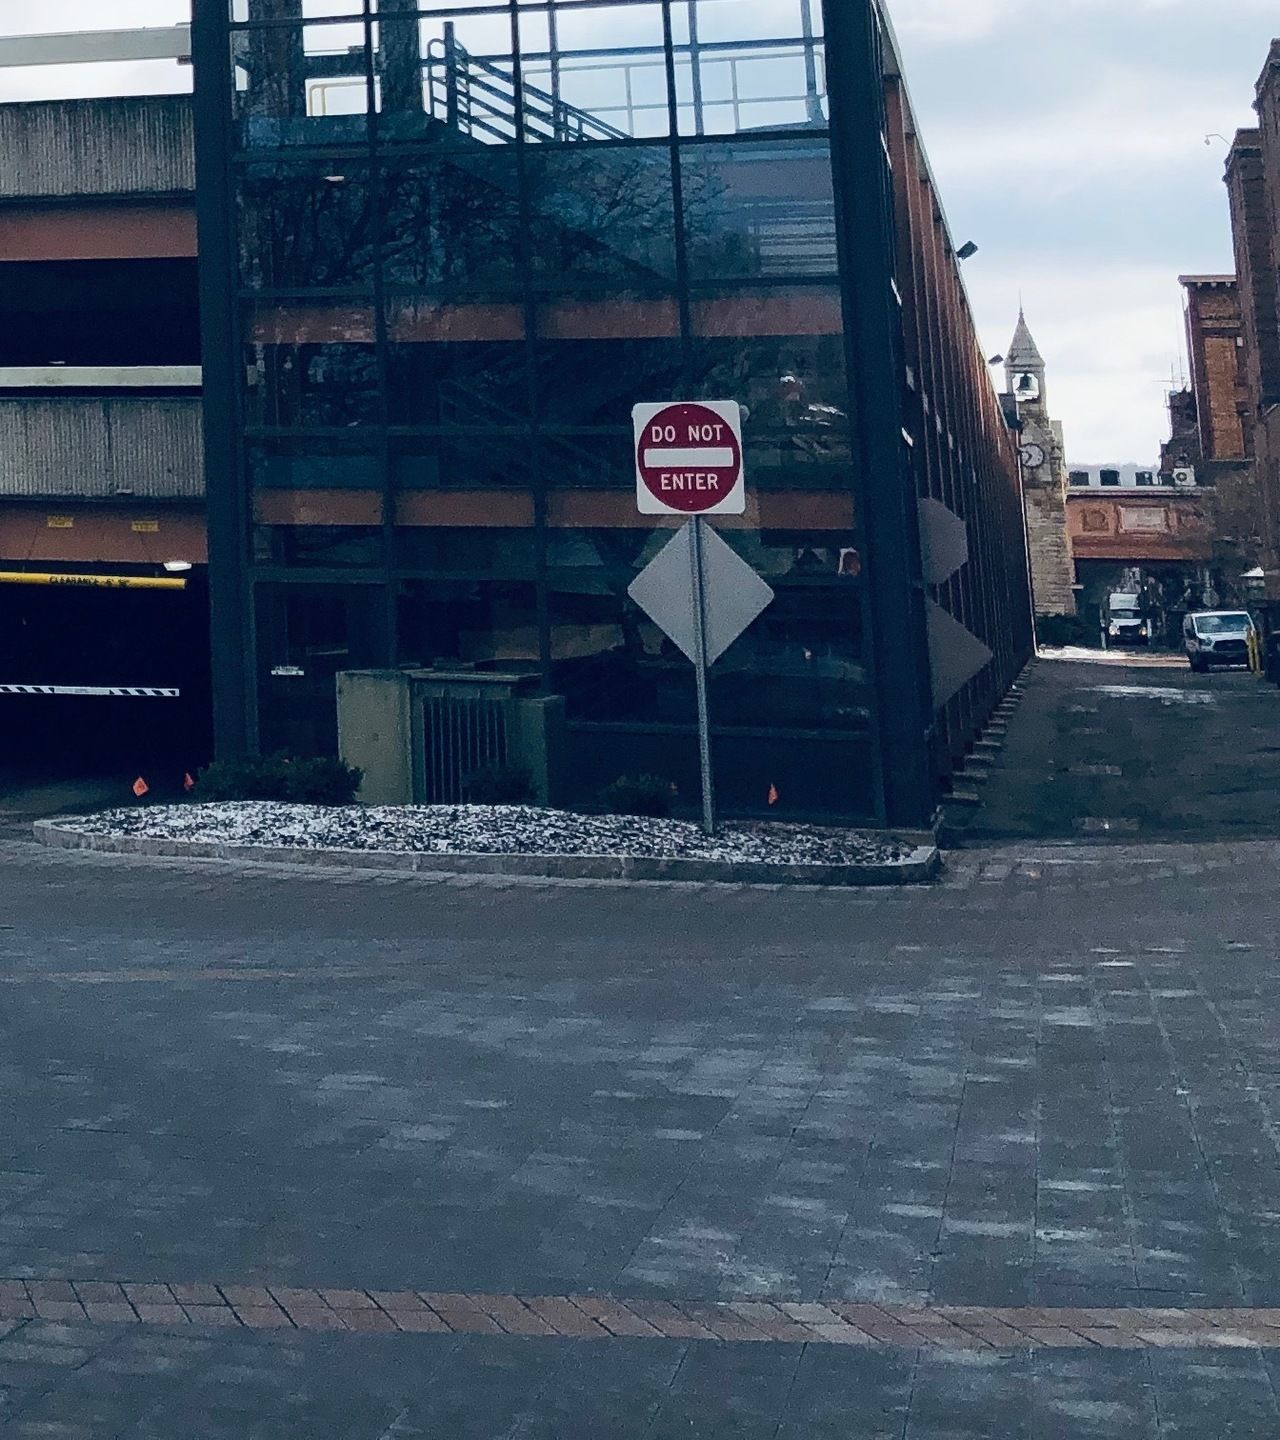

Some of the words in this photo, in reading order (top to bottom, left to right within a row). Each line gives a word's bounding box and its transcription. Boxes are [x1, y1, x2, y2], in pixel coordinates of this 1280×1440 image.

[651, 425, 676, 442] DO
[687, 424, 724, 442] NOT
[660, 473, 719, 491] ENTER
